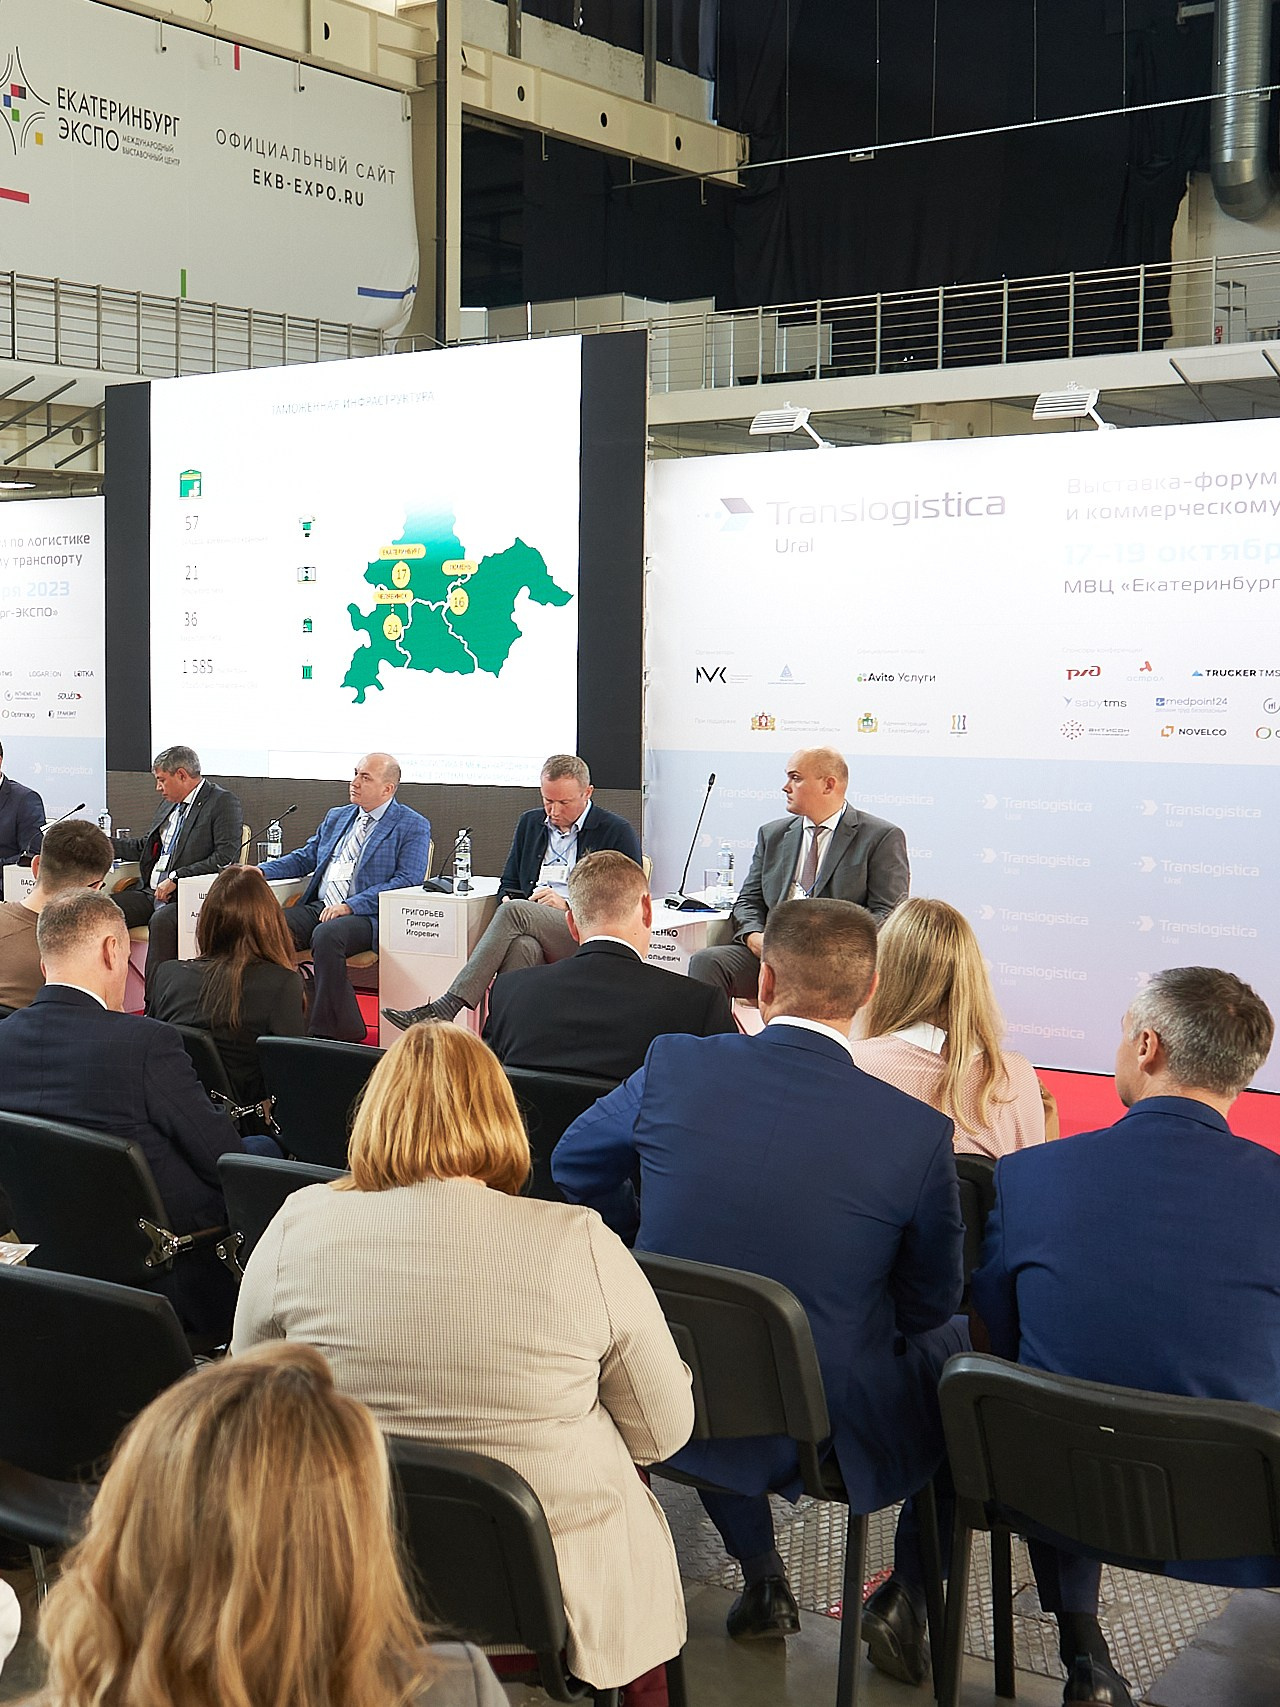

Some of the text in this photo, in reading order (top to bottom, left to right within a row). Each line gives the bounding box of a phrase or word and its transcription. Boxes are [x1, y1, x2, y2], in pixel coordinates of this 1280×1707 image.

[57, 86, 180, 137] ЕКАТЕРИНБУРГ
[58, 117, 120, 152] ЭКСПО
[122, 135, 175, 154] МЕЖДУНАРОДНЫЙ
[216, 128, 396, 185] ОФИЦИАЛЬНЫЙ САЙТ
[253, 168, 365, 207] EKB-EXPO.RU
[1067, 471, 1279, 494] Выставка-форум
[766, 491, 1007, 526] Translogistica
[1066, 499, 1280, 520] и коммерческому
[27, 533, 91, 547] логистике
[775, 536, 814, 553] Ural
[12, 553, 83, 568] транспорту
[397, 568, 407, 580] 17
[26, 581, 70, 597] 2023
[1064, 579, 1115, 595] МВЦ
[387, 624, 399, 635] 24
[868, 672, 936, 684] Avito Услуги
[1205, 669, 1257, 677] TRUCKER
[1178, 728, 1227, 736] NOVELCO
[1001, 797, 1092, 813] Translogistica
[1162, 803, 1261, 820] Translogistica
[1000, 851, 1091, 868] Translogistica
[1160, 859, 1260, 877] Translogistica
[401, 907, 445, 918] ГРИГОРЬЕВ
[998, 907, 1089, 925] Translogistica
[406, 918, 440, 929] Григорий
[1158, 919, 1258, 938] Translogistica
[405, 928, 440, 938] Игоревич
[996, 962, 1088, 980] Translogistica
